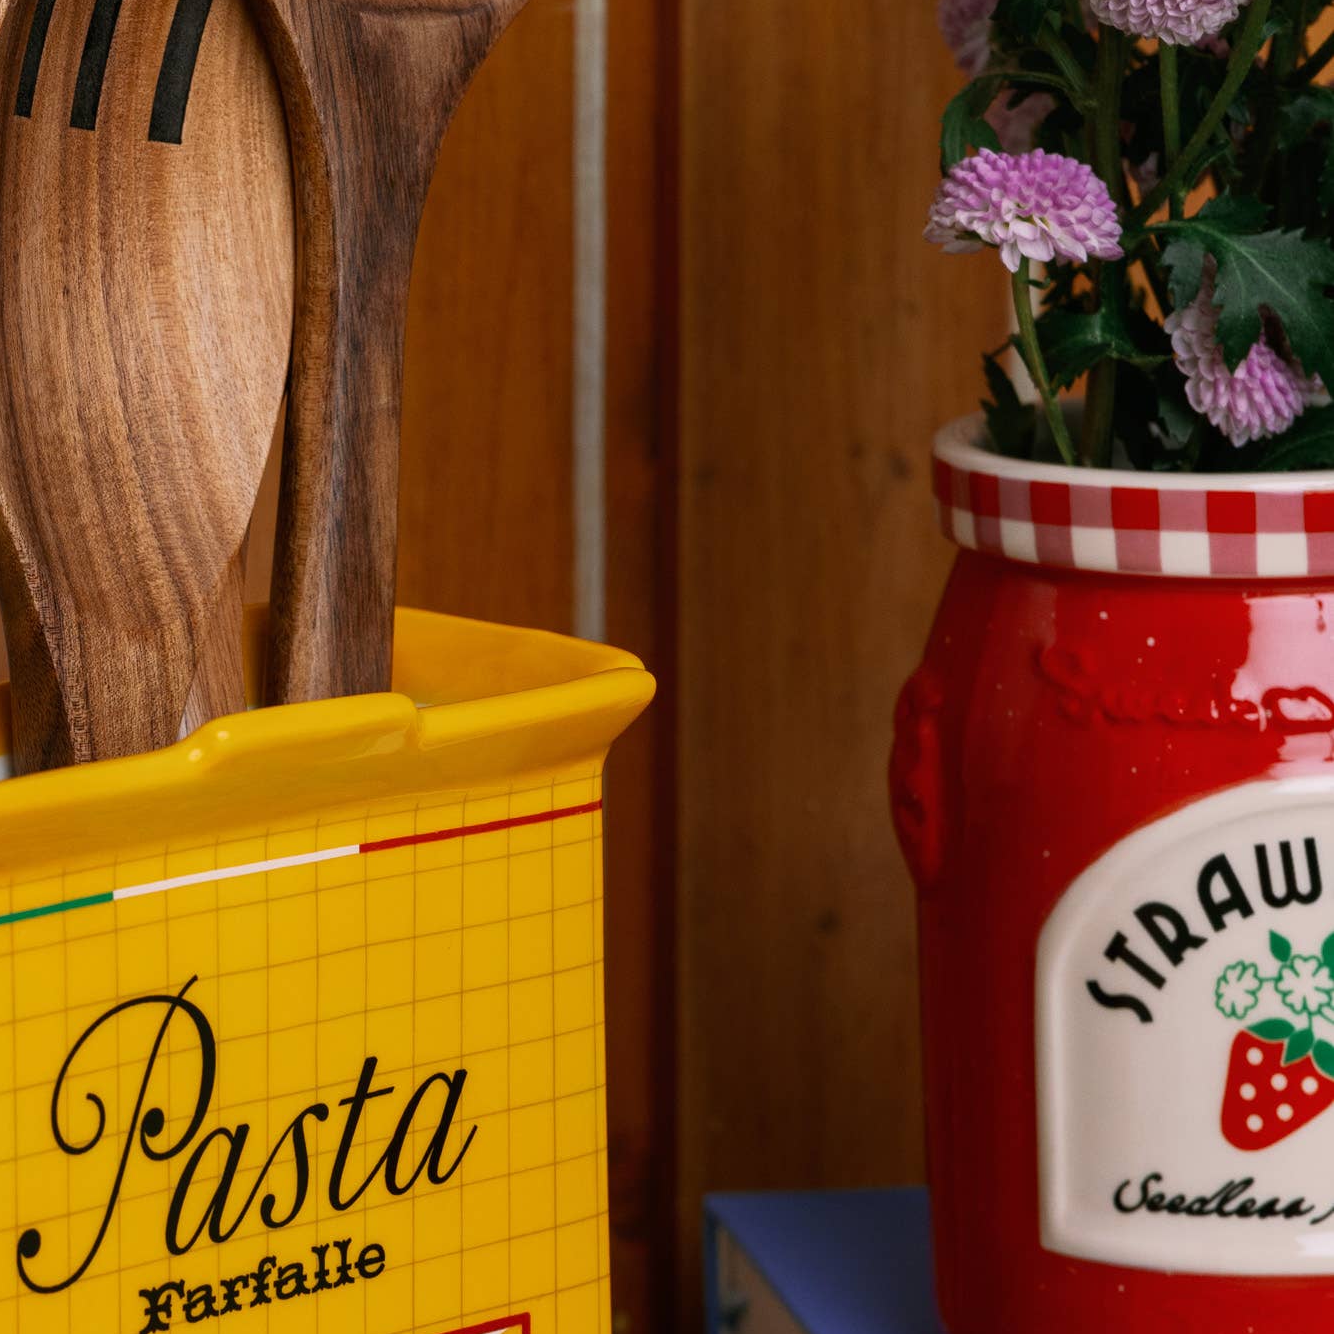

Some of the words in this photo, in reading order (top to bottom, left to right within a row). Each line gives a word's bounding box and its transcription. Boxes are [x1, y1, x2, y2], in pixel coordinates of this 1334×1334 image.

[1085, 836, 1322, 1024] STRAW
[16, 974, 478, 1295] Pasta
[1113, 1172, 1315, 1220] Seedless
